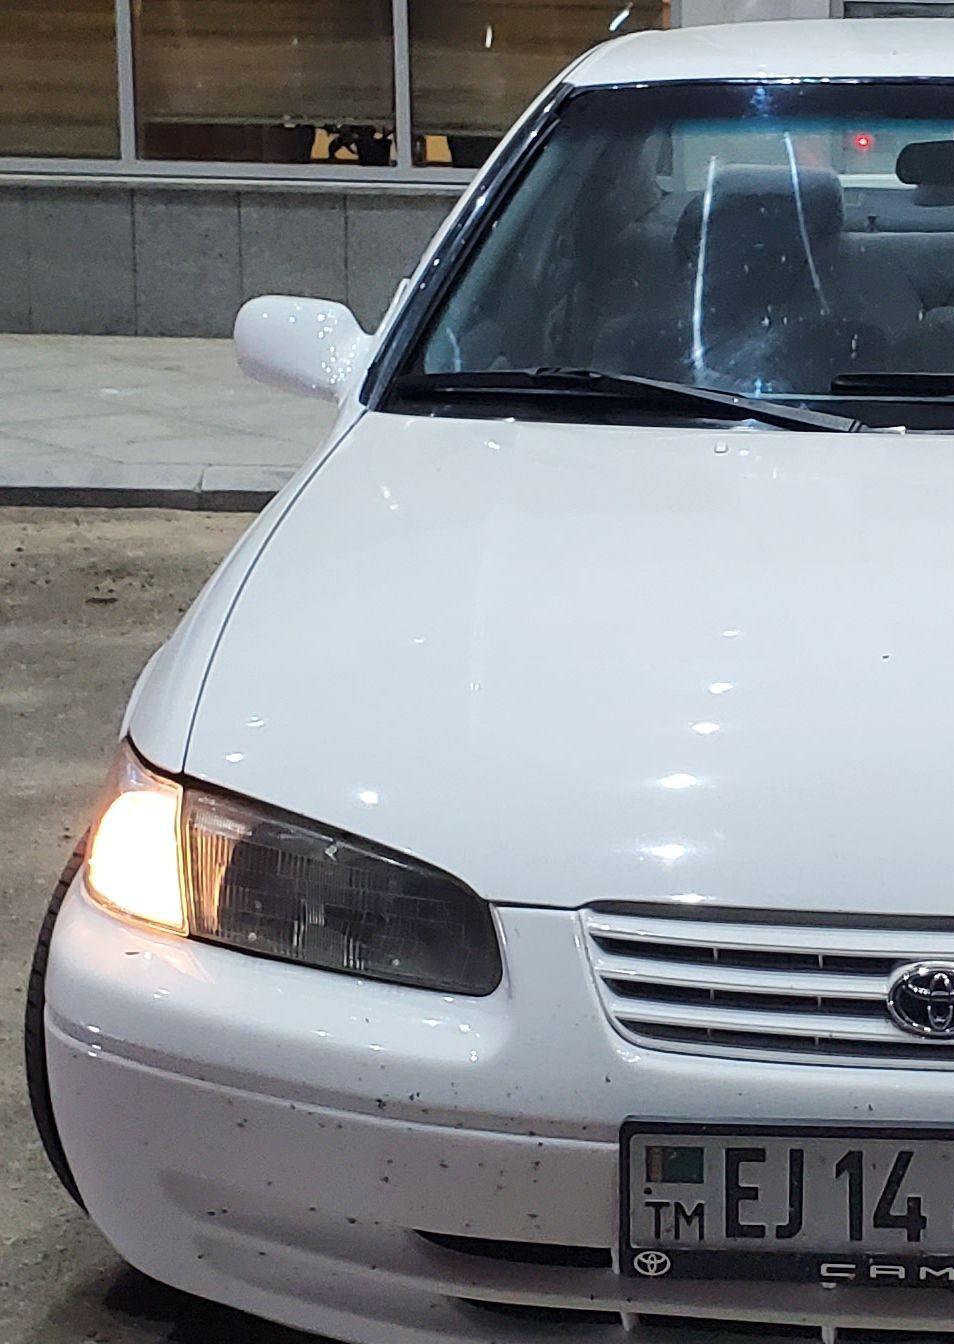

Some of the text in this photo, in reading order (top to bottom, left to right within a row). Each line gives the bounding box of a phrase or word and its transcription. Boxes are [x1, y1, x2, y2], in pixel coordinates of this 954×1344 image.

[645, 1200, 705, 1241] TM
[725, 1147, 804, 1239] EJ
[835, 1150, 927, 1242] 14
